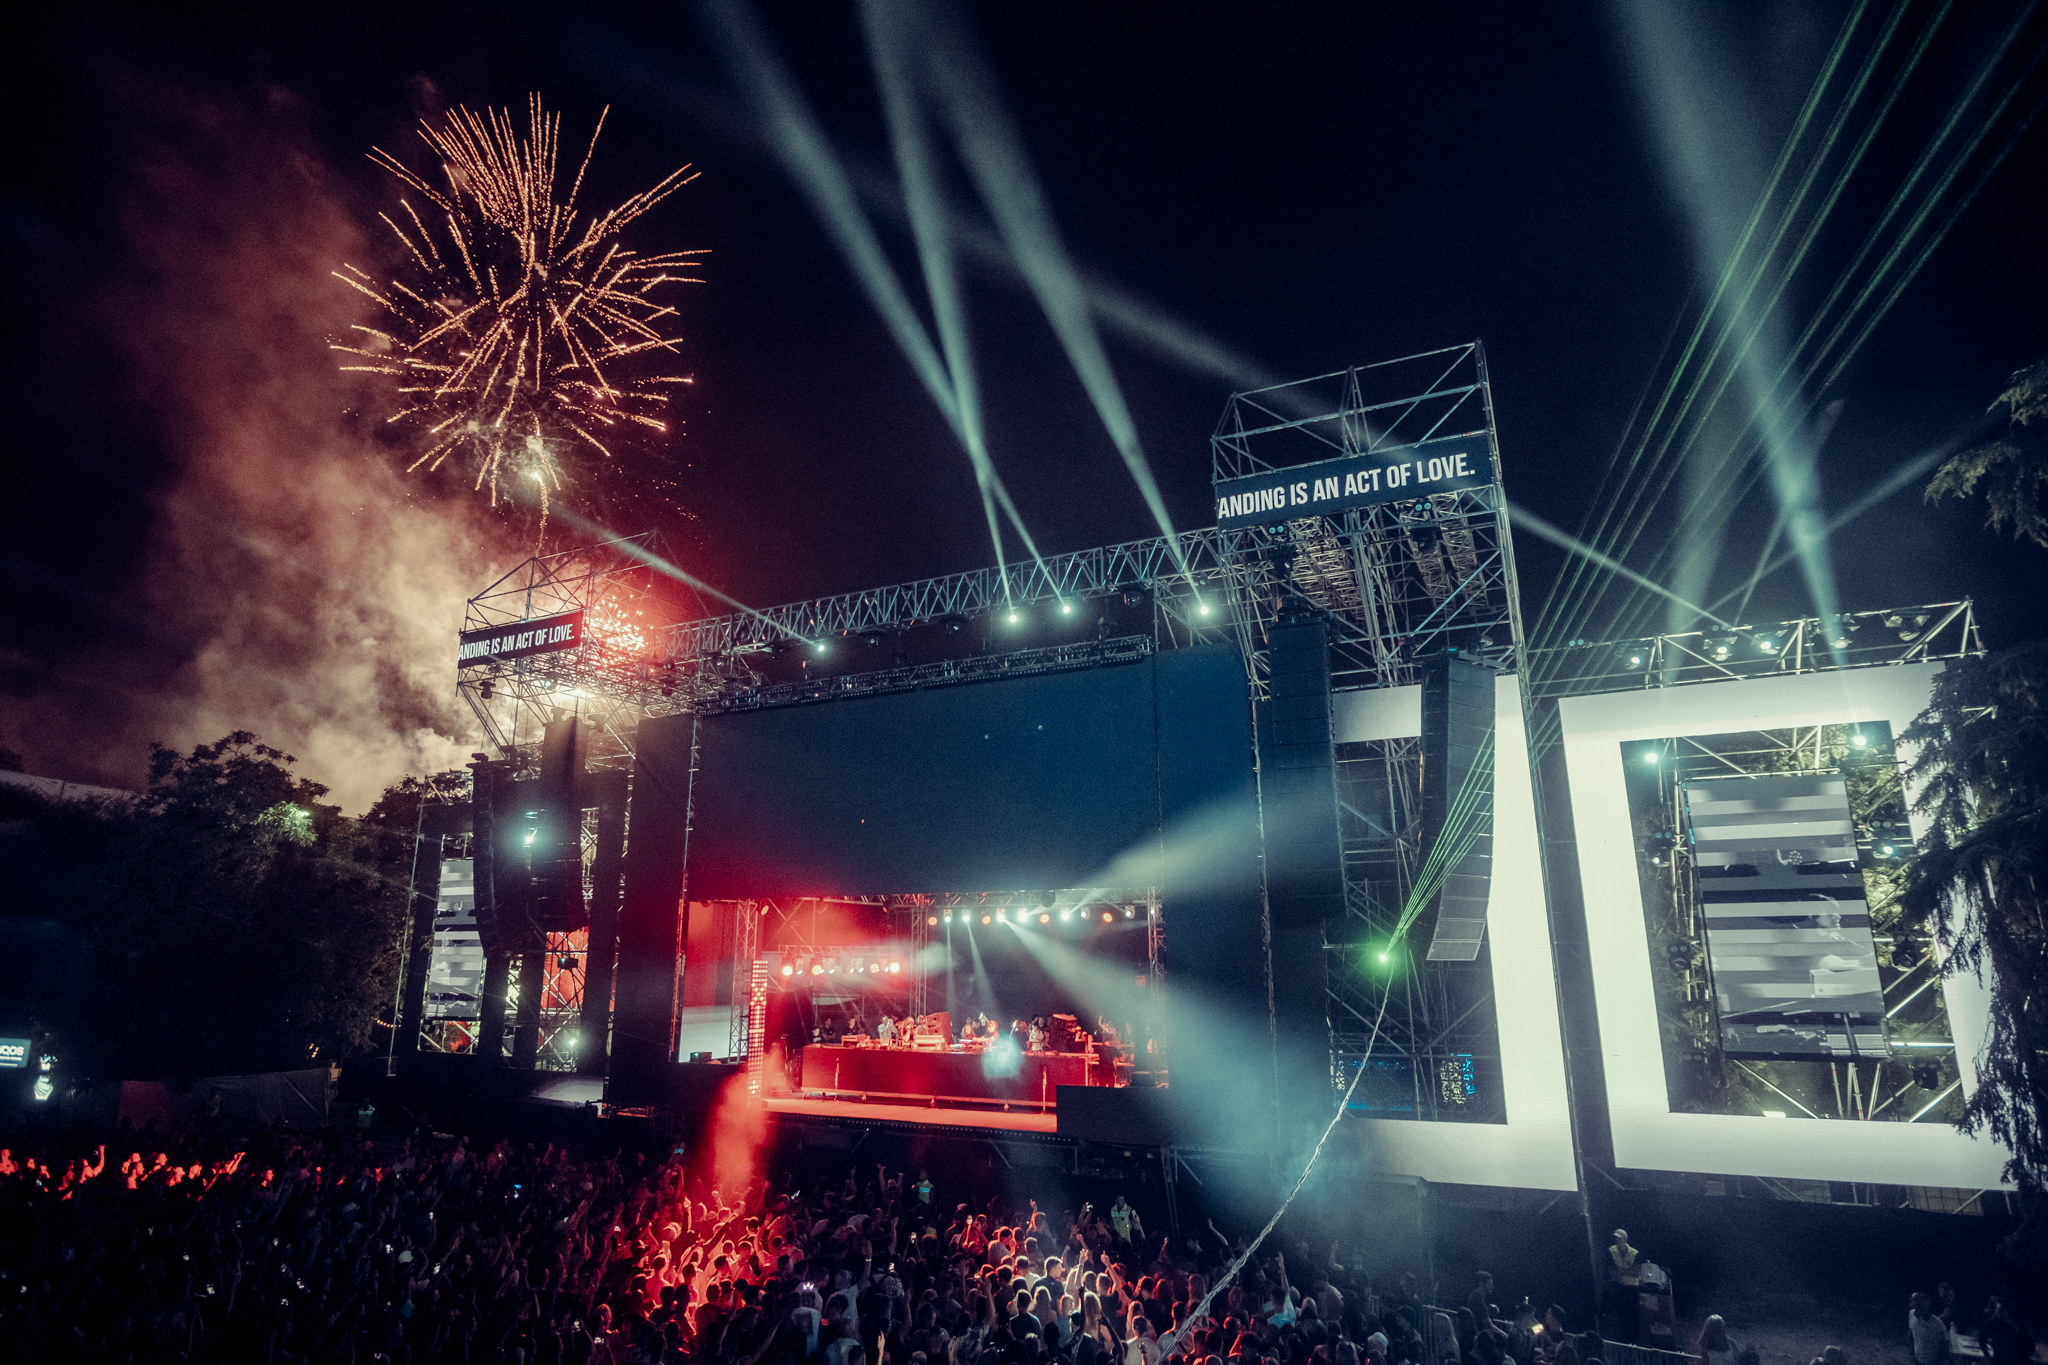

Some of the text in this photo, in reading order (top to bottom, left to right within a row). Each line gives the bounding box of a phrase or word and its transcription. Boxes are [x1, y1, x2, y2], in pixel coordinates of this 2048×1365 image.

[1218, 453, 1476, 519] ANDING IS AN ACT OF LOVE.
[491, 637, 500, 654] IS
[501, 635, 515, 652] AN
[515, 631, 534, 649] ACT
[535, 629, 548, 646] OF
[549, 624, 574, 643] LOVE.
